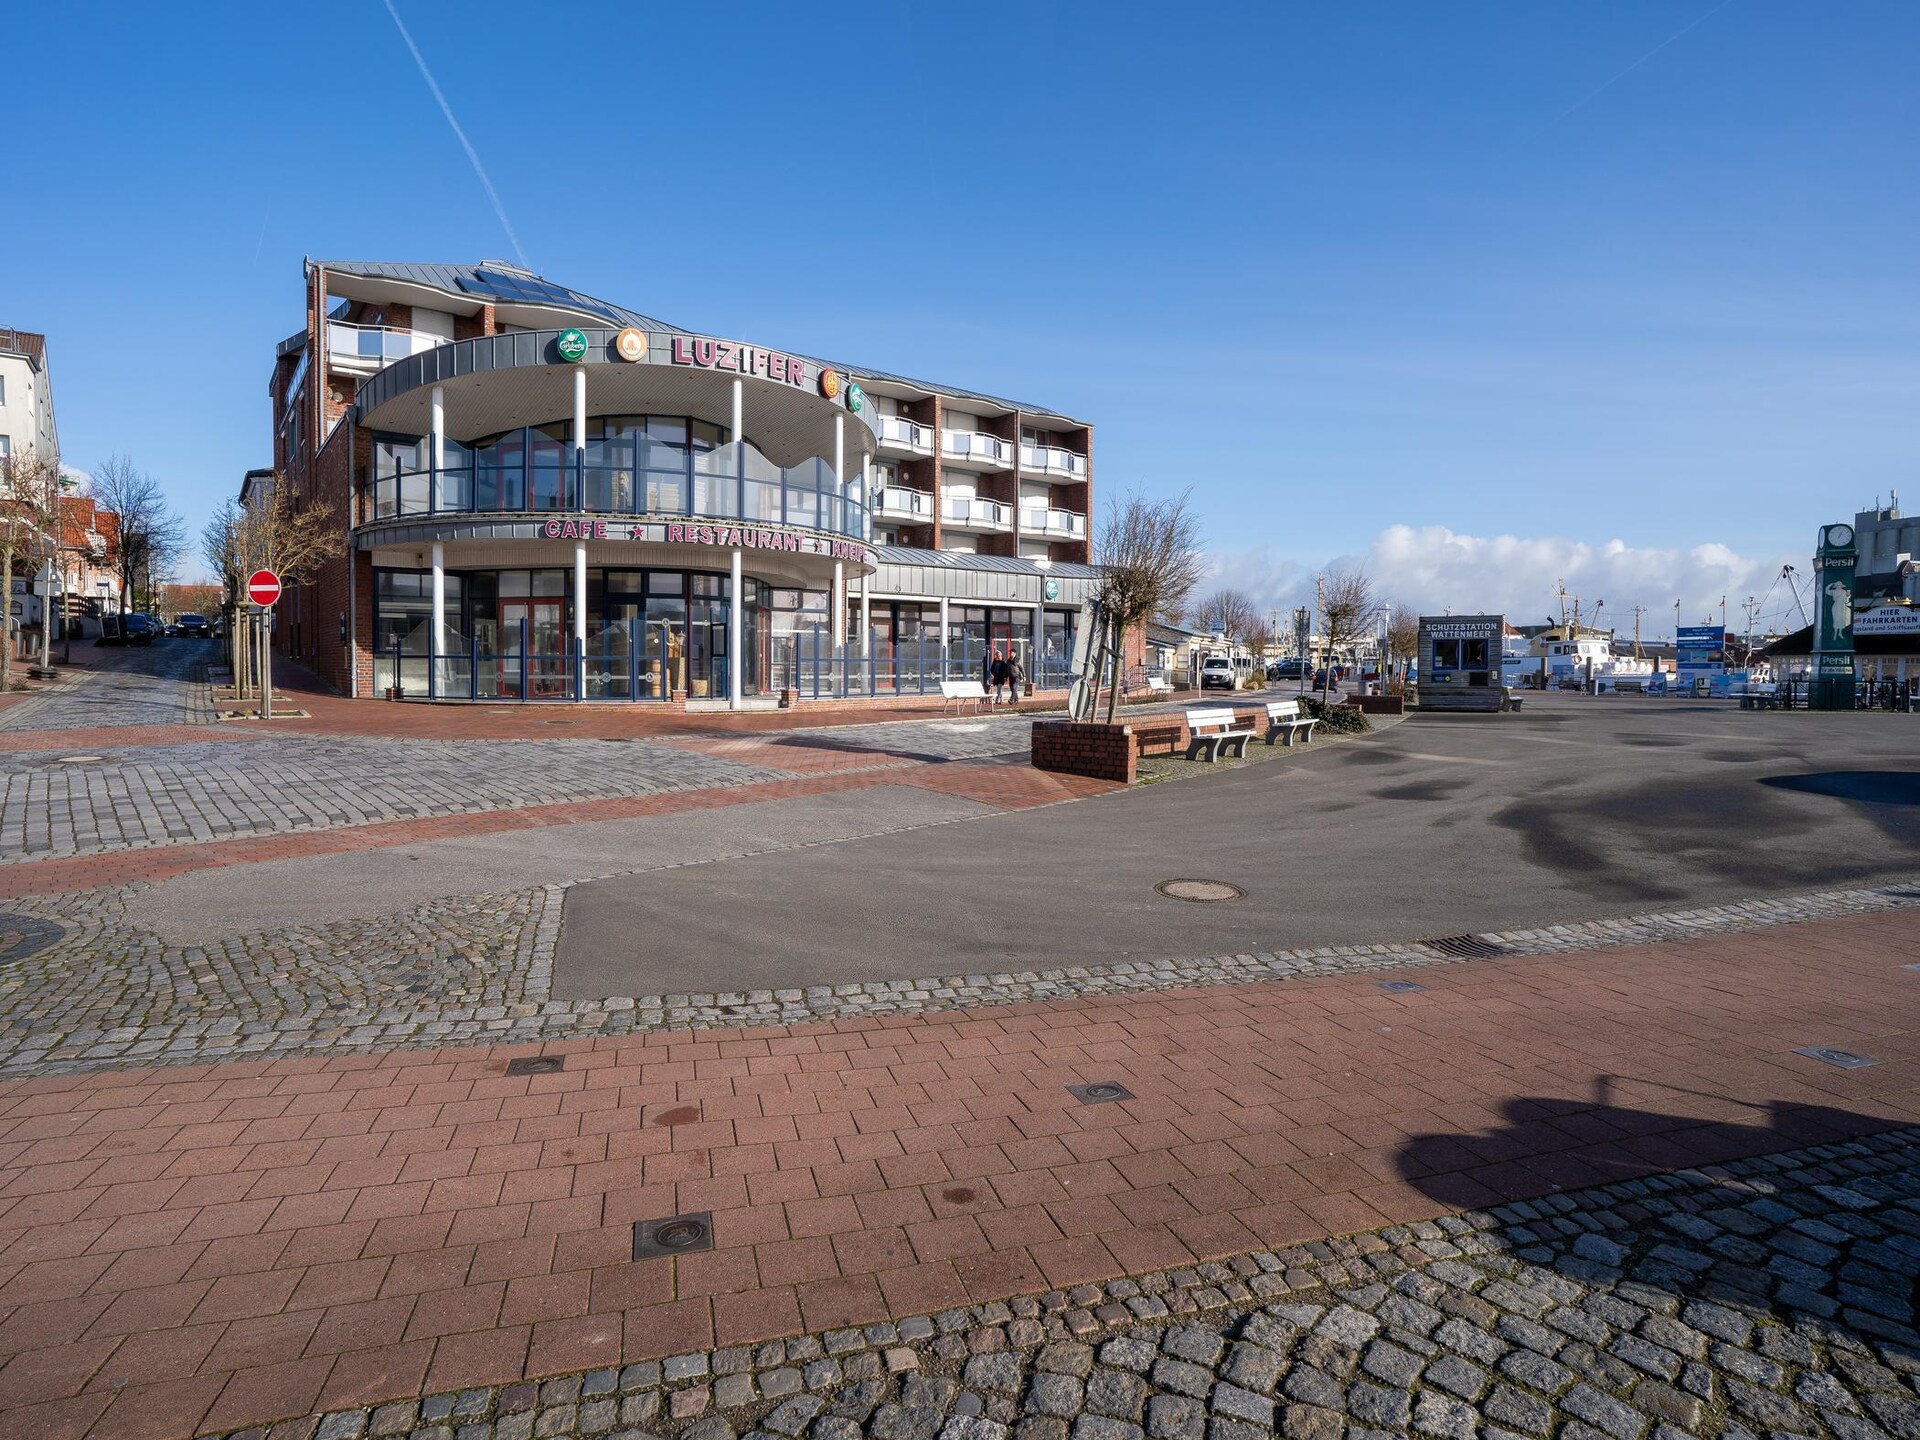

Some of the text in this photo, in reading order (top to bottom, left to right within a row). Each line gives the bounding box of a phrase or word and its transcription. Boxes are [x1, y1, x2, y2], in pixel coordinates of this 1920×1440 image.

[674, 337, 804, 385] LUZIFER
[545, 520, 868, 562] CAFE RESTAURANT KNEIPE
[1825, 557, 1854, 567] Persil
[1862, 616, 1918, 624] FAHRKARTEN
[1426, 623, 1497, 631] SCHUTZSTATION
[1823, 656, 1850, 665] Persil
